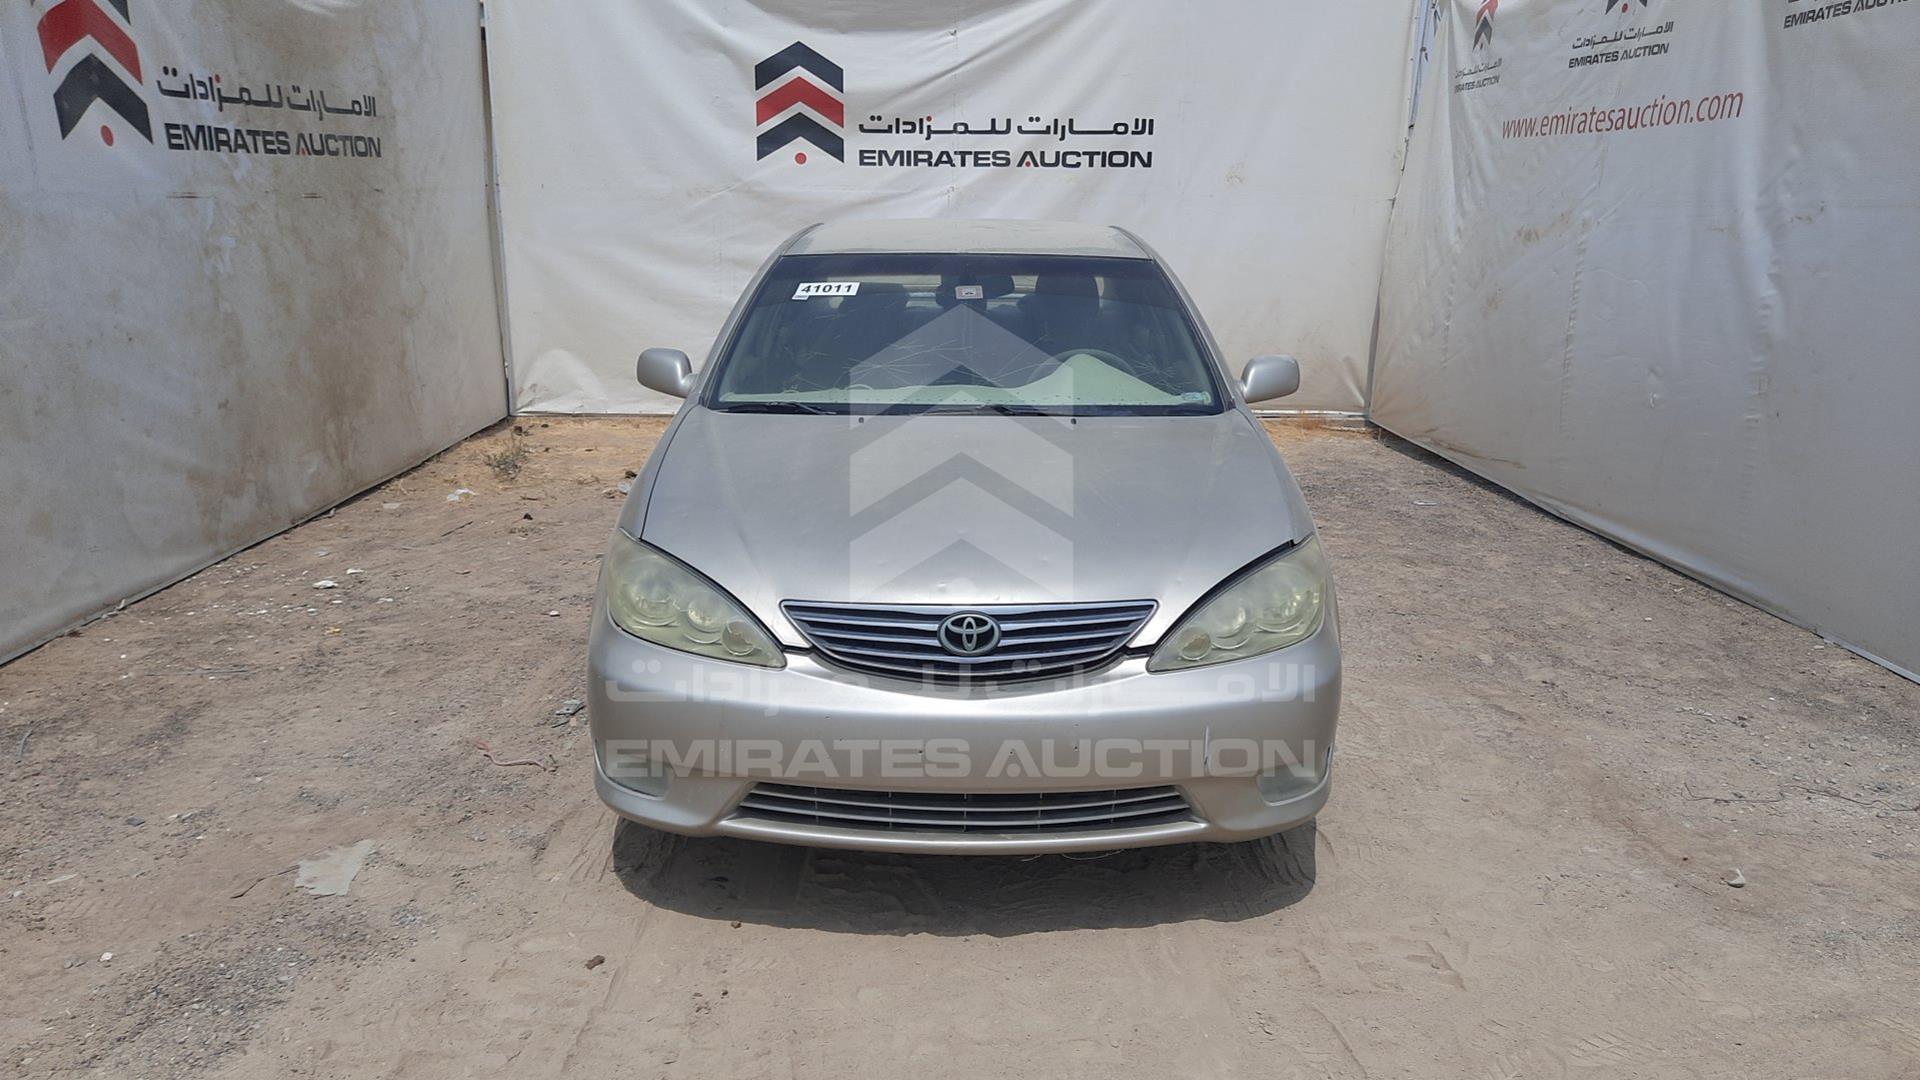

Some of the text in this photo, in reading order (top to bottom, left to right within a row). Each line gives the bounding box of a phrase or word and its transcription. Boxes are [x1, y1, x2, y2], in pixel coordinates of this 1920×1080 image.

[1783, 1, 1852, 29] EMIRATES
[1568, 43, 1670, 68] EMIRATES AUCTION
[1502, 91, 1744, 139] www.emiratesauction.com
[164, 123, 382, 158] EMIRATES AUCTION
[1017, 116, 1155, 141] الامارات
[858, 149, 1153, 168] EMIRATES AUCTION
[801, 284, 852, 293] 41011
